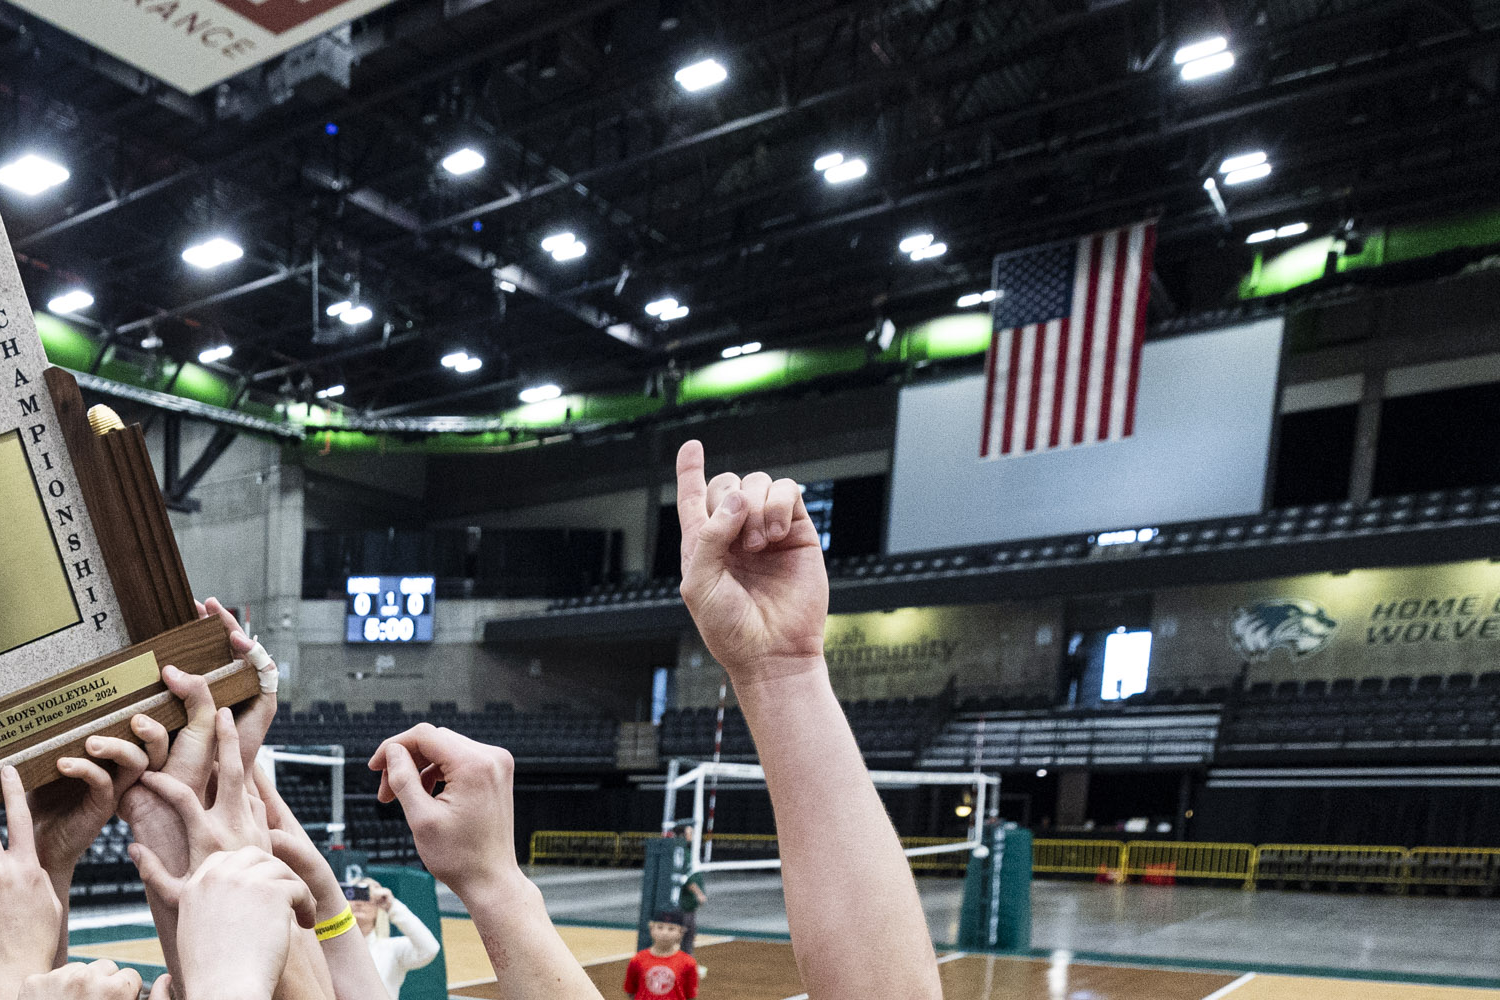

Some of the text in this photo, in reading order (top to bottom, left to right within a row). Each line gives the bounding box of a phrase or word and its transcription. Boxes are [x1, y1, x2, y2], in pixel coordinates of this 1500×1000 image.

[135, 0, 256, 59] ANCE
[1371, 597, 1479, 619] HOME
[6, 707, 36, 725] BOYS
[37, 676, 110, 709] VOLLEYBALL
[19, 721, 34, 734] 1st
[36, 711, 64, 727] Place
[65, 700, 88, 714] 2023
[95, 686, 118, 701] 2024
